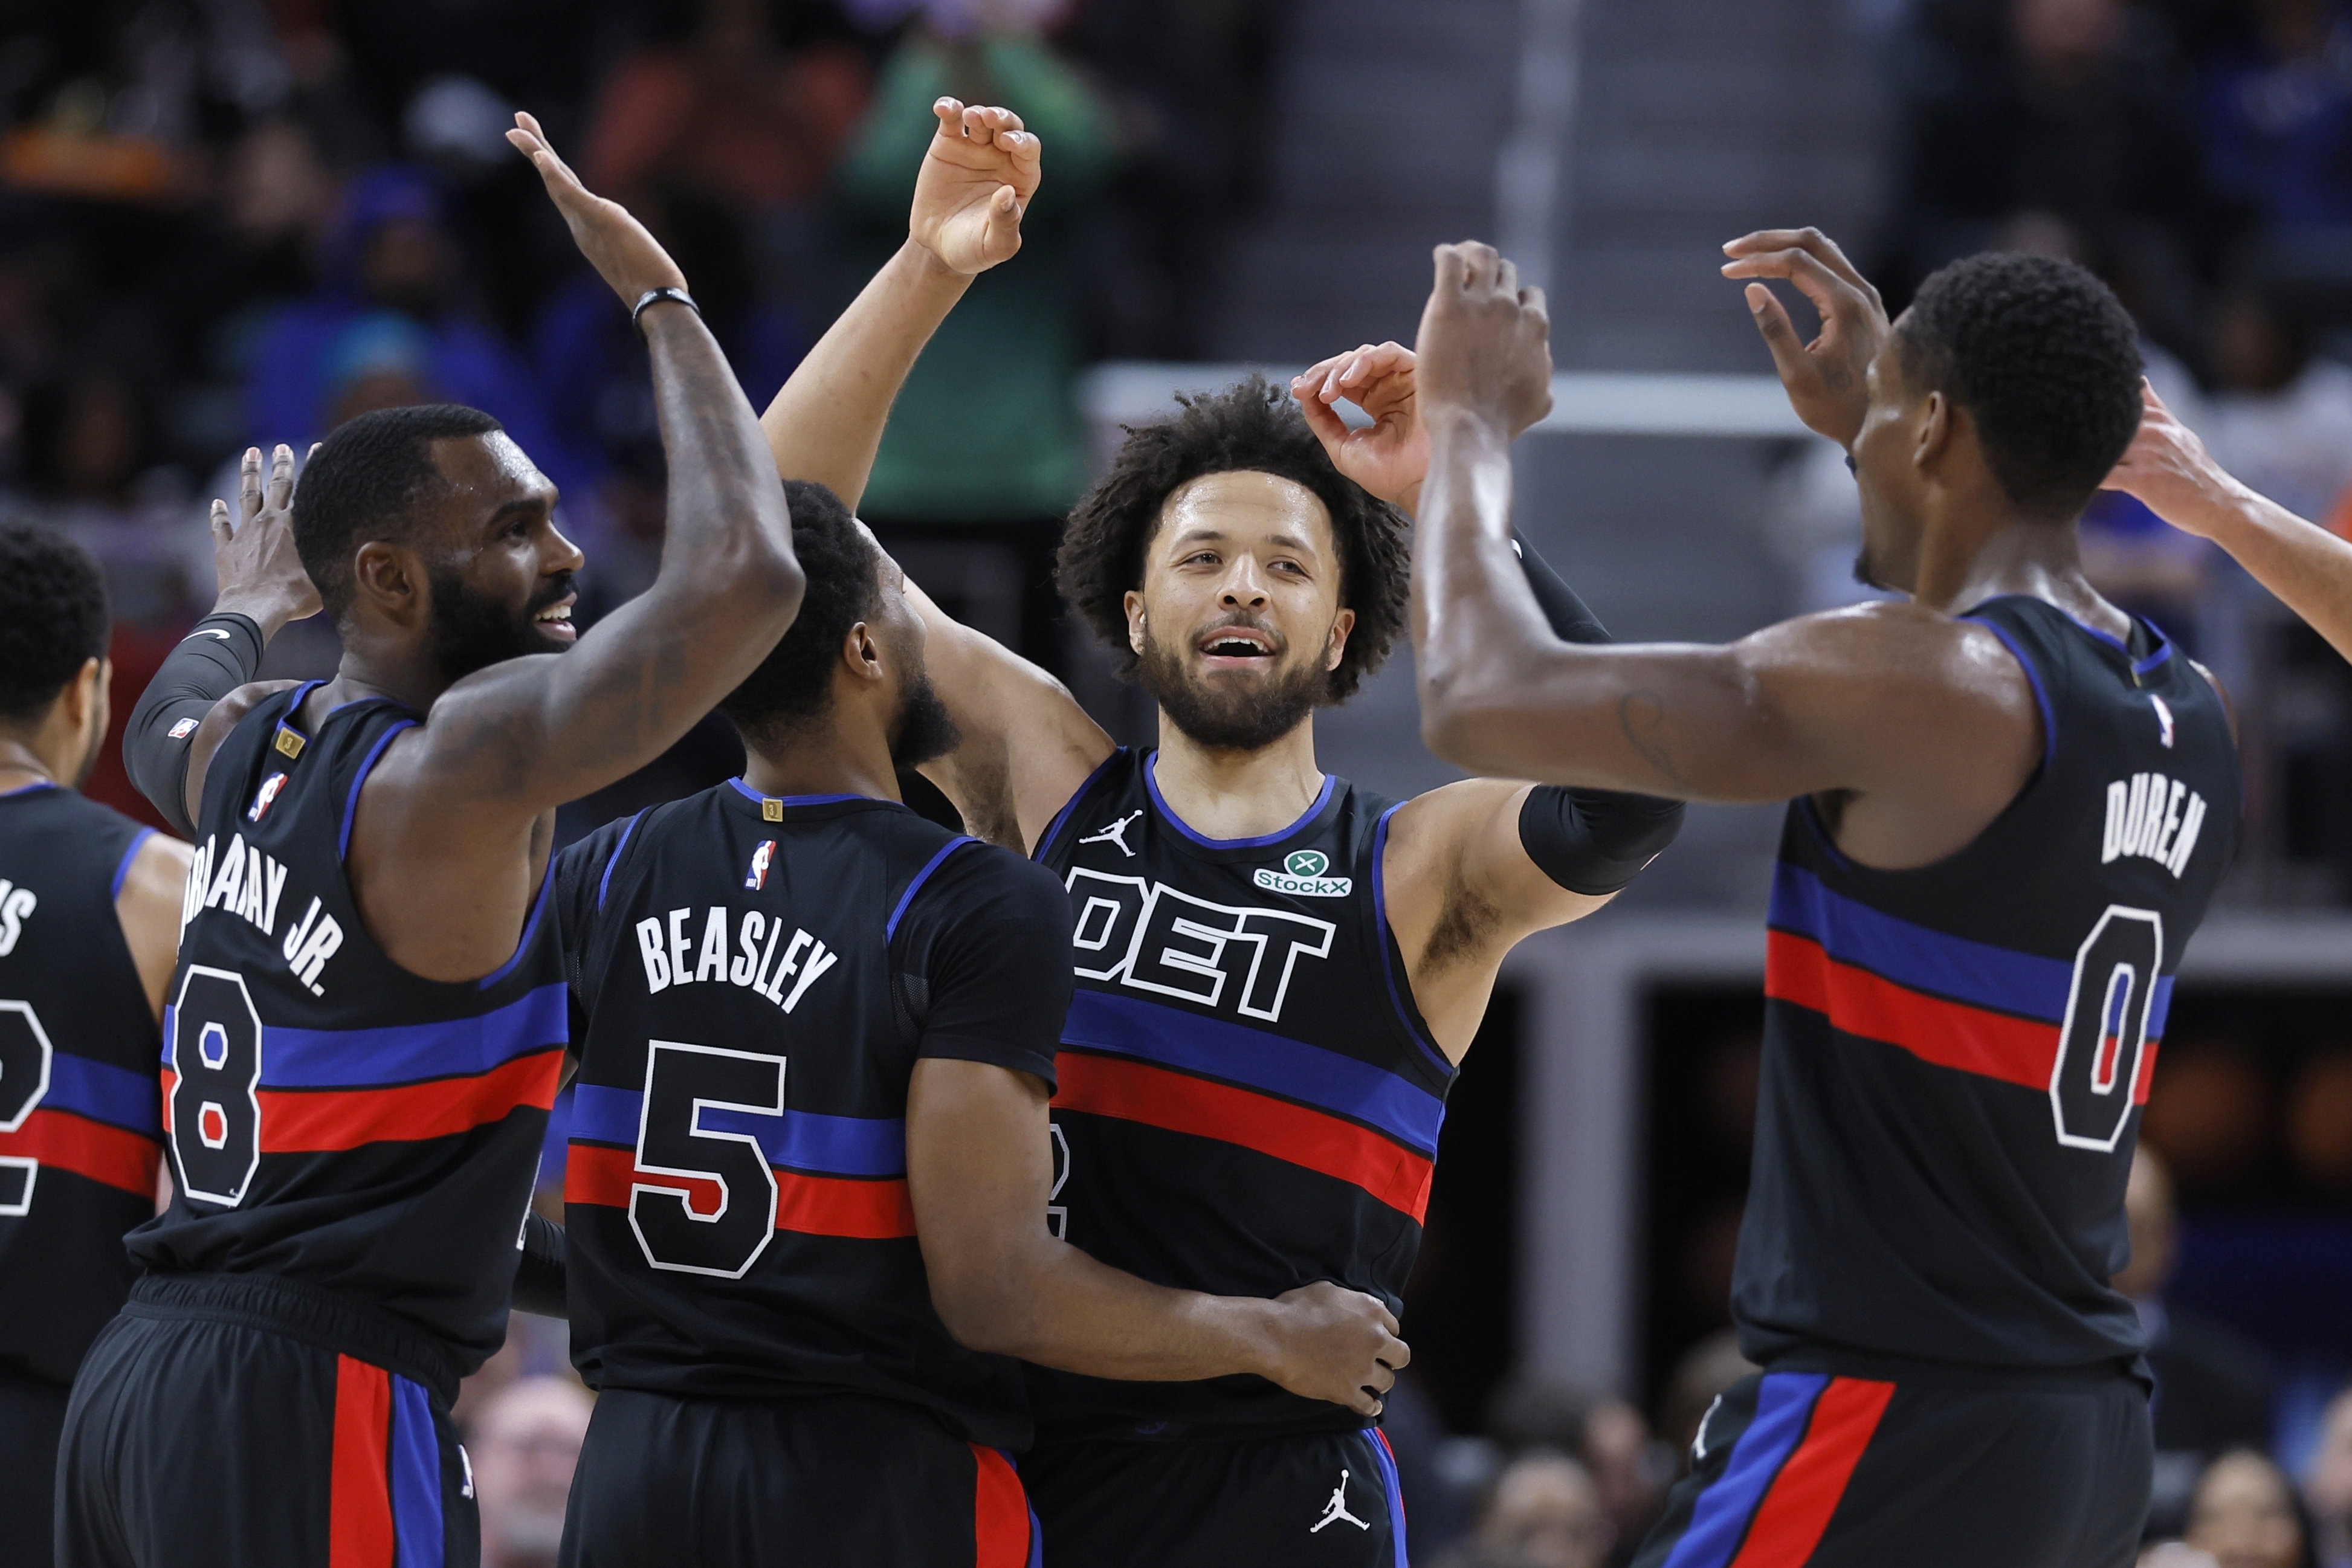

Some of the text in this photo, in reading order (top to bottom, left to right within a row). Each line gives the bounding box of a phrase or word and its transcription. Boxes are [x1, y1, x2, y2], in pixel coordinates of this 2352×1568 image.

[1258, 872, 1348, 894] StockX
[2101, 773, 2207, 879] DUREN
[283, 895, 344, 997] JR.
[636, 906, 838, 1014] BEASLEY
[1066, 866, 1337, 1023] DET
[169, 964, 262, 1207] 8
[2049, 905, 2163, 1153] 0
[628, 1039, 787, 1279] 5
